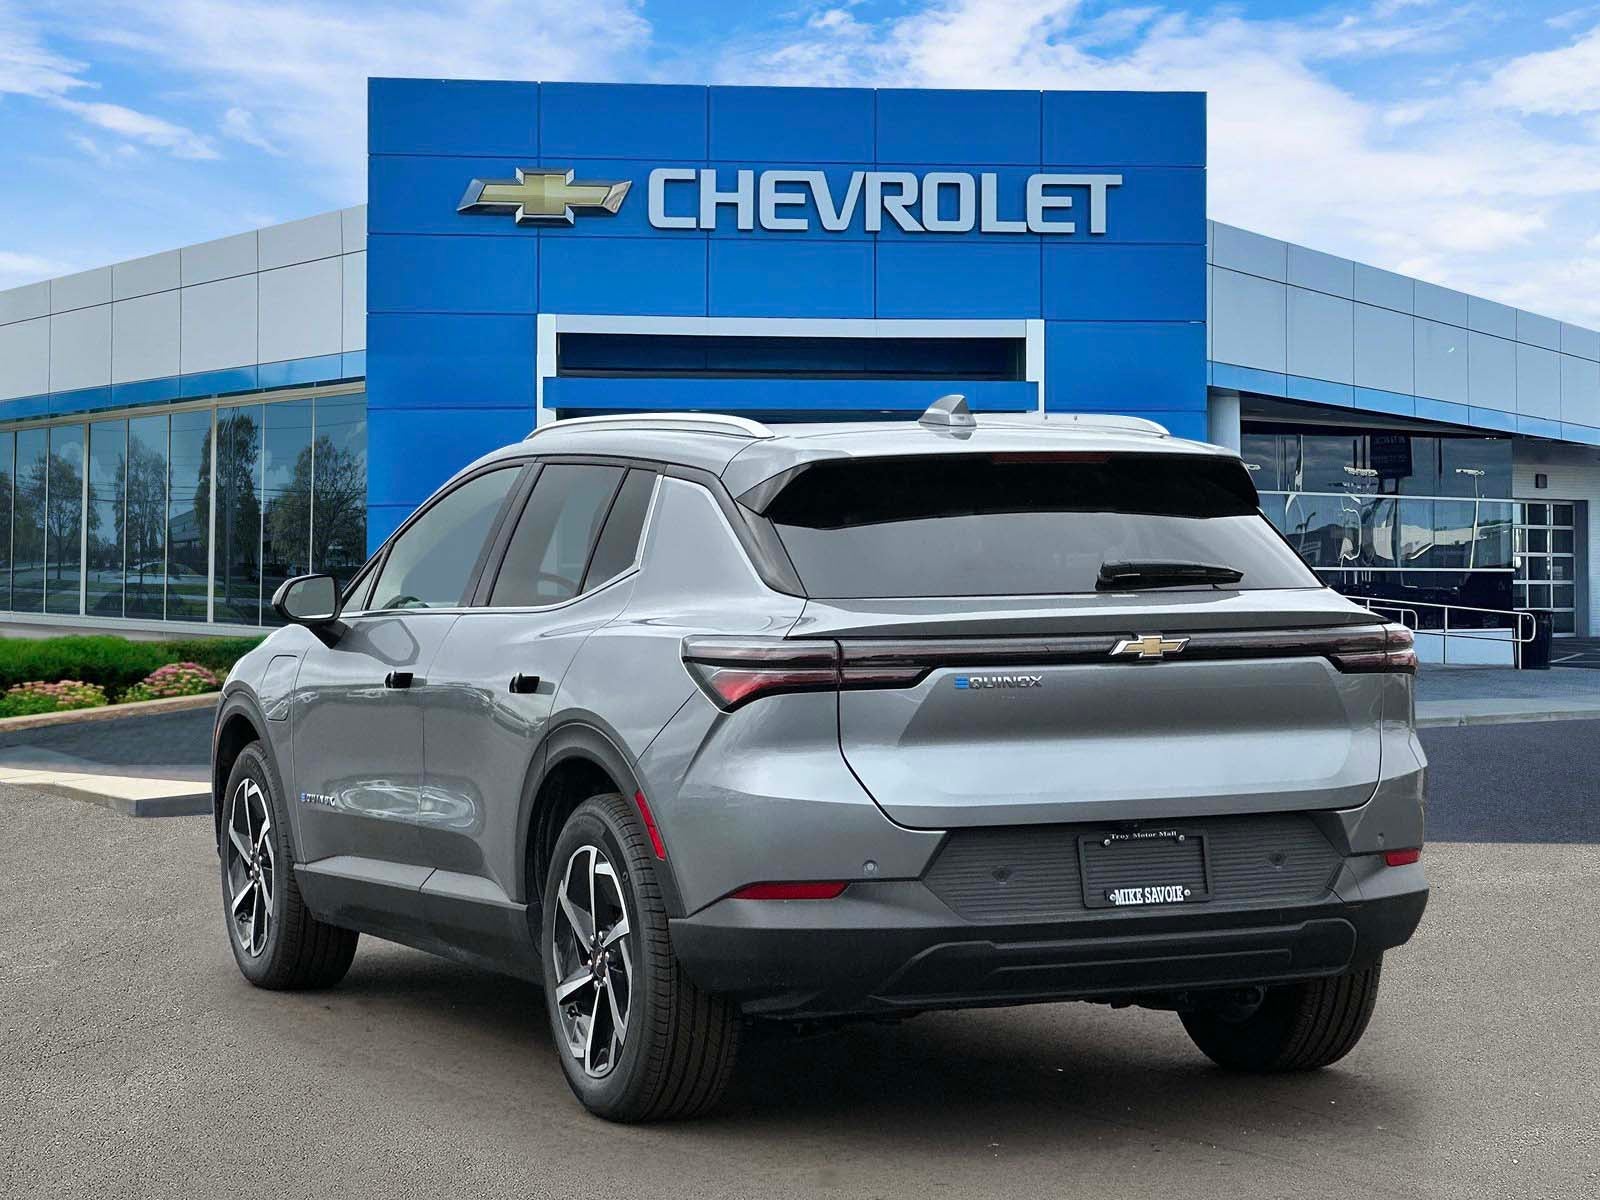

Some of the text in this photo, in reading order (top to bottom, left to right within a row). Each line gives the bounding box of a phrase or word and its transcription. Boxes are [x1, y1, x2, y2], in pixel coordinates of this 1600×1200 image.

[648, 168, 1123, 234] CHEVROLET
[954, 675, 1043, 689] EQUINOX
[1114, 885, 1184, 905] MIKE SAVOIE
